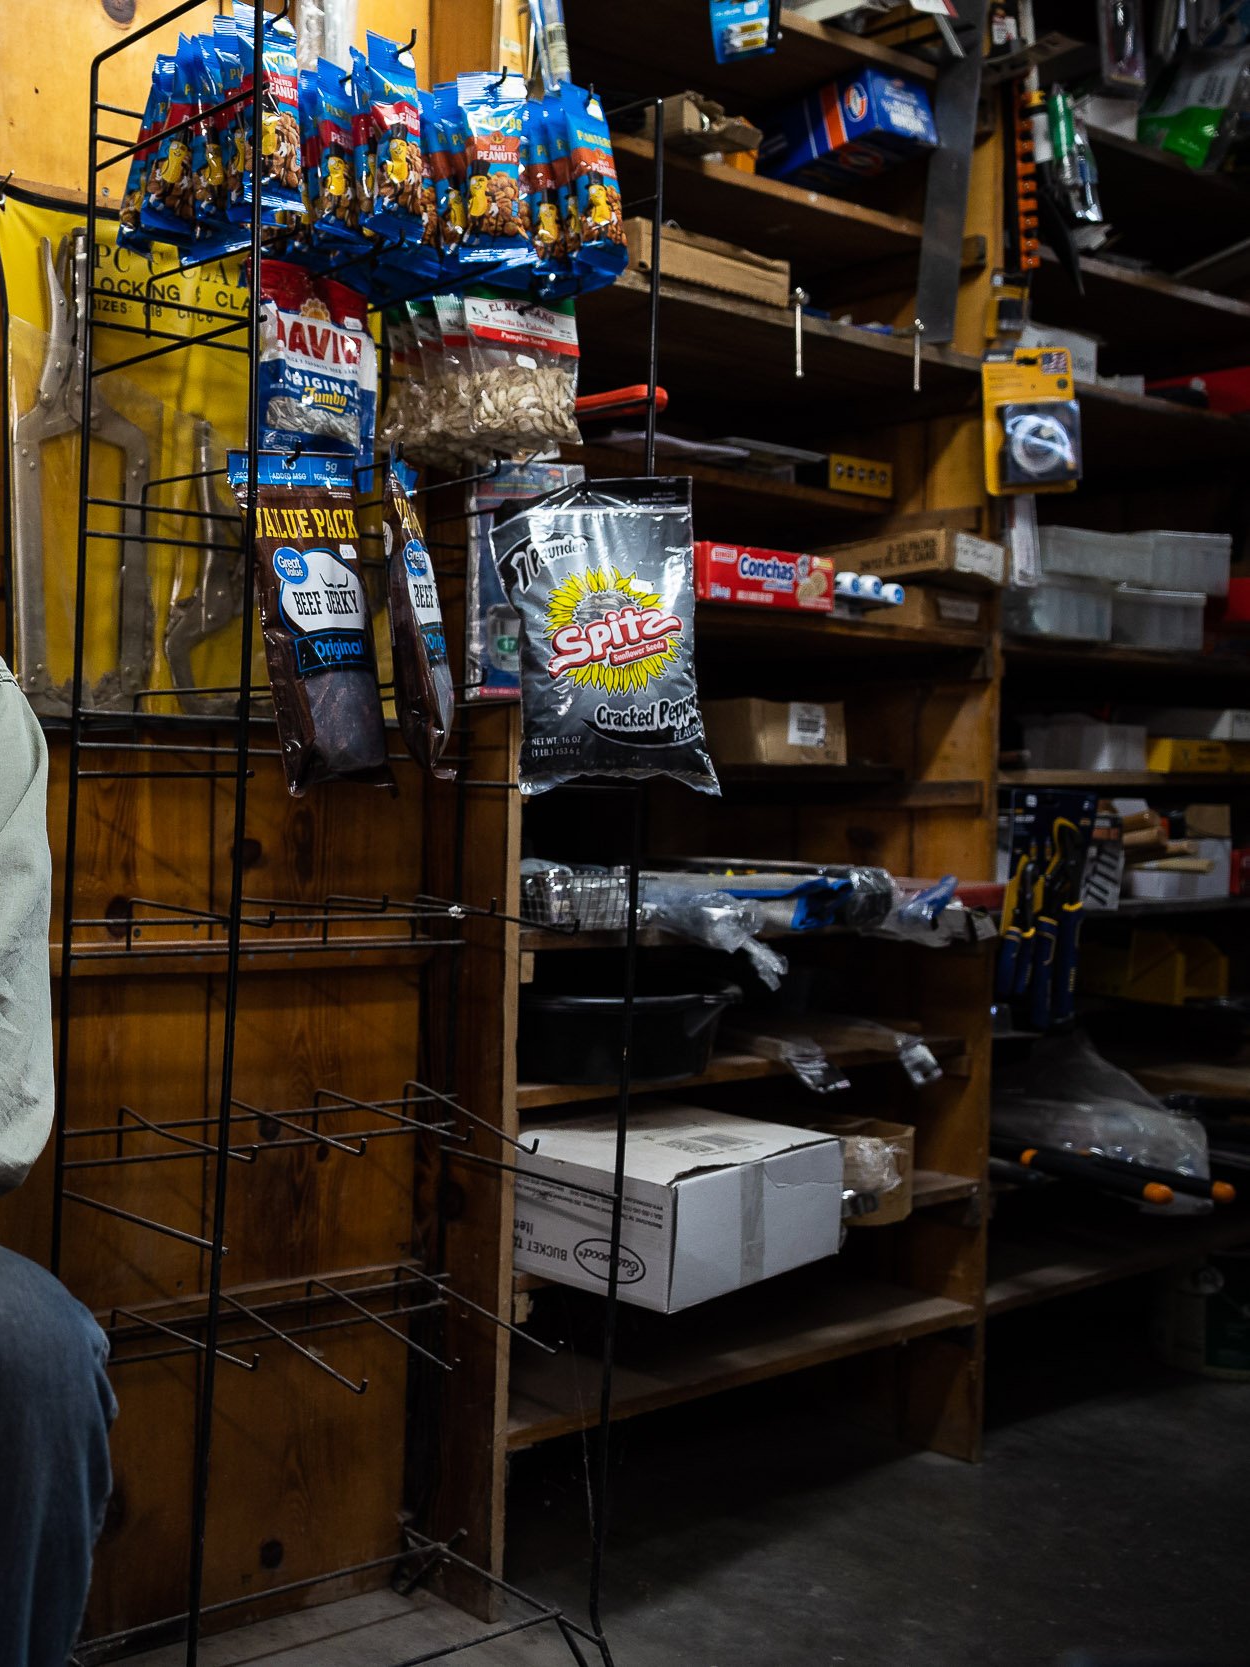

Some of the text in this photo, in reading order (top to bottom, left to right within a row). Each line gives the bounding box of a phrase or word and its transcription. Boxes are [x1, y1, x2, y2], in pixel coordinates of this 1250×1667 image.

[477, 150, 518, 163] PEANUTS
[500, 331, 530, 343] Pumpkin
[285, 368, 360, 400] ORIGINAL
[302, 386, 348, 408] Jumbo
[292, 472, 307, 480] MSG
[325, 460, 338, 474] 5g
[310, 508, 360, 539] PACK
[277, 555, 302, 569] Great
[526, 537, 589, 578] Punder
[739, 555, 796, 582] Conchas
[286, 567, 304, 577] Value
[292, 590, 360, 616] BEEF JERKY
[413, 584, 434, 609] BEEF
[314, 638, 365, 661] Original
[426, 633, 446, 651] Orig
[548, 607, 684, 678] Spitz
[613, 640, 665, 663] Sunflower Seeds
[596, 703, 658, 730] Cracked
[531, 735, 582, 746] NET WT. 16 OZ
[531, 748, 538, 758] (1
[539, 747, 554, 757] LB.)
[527, 1240, 568, 1262] BUCKET
